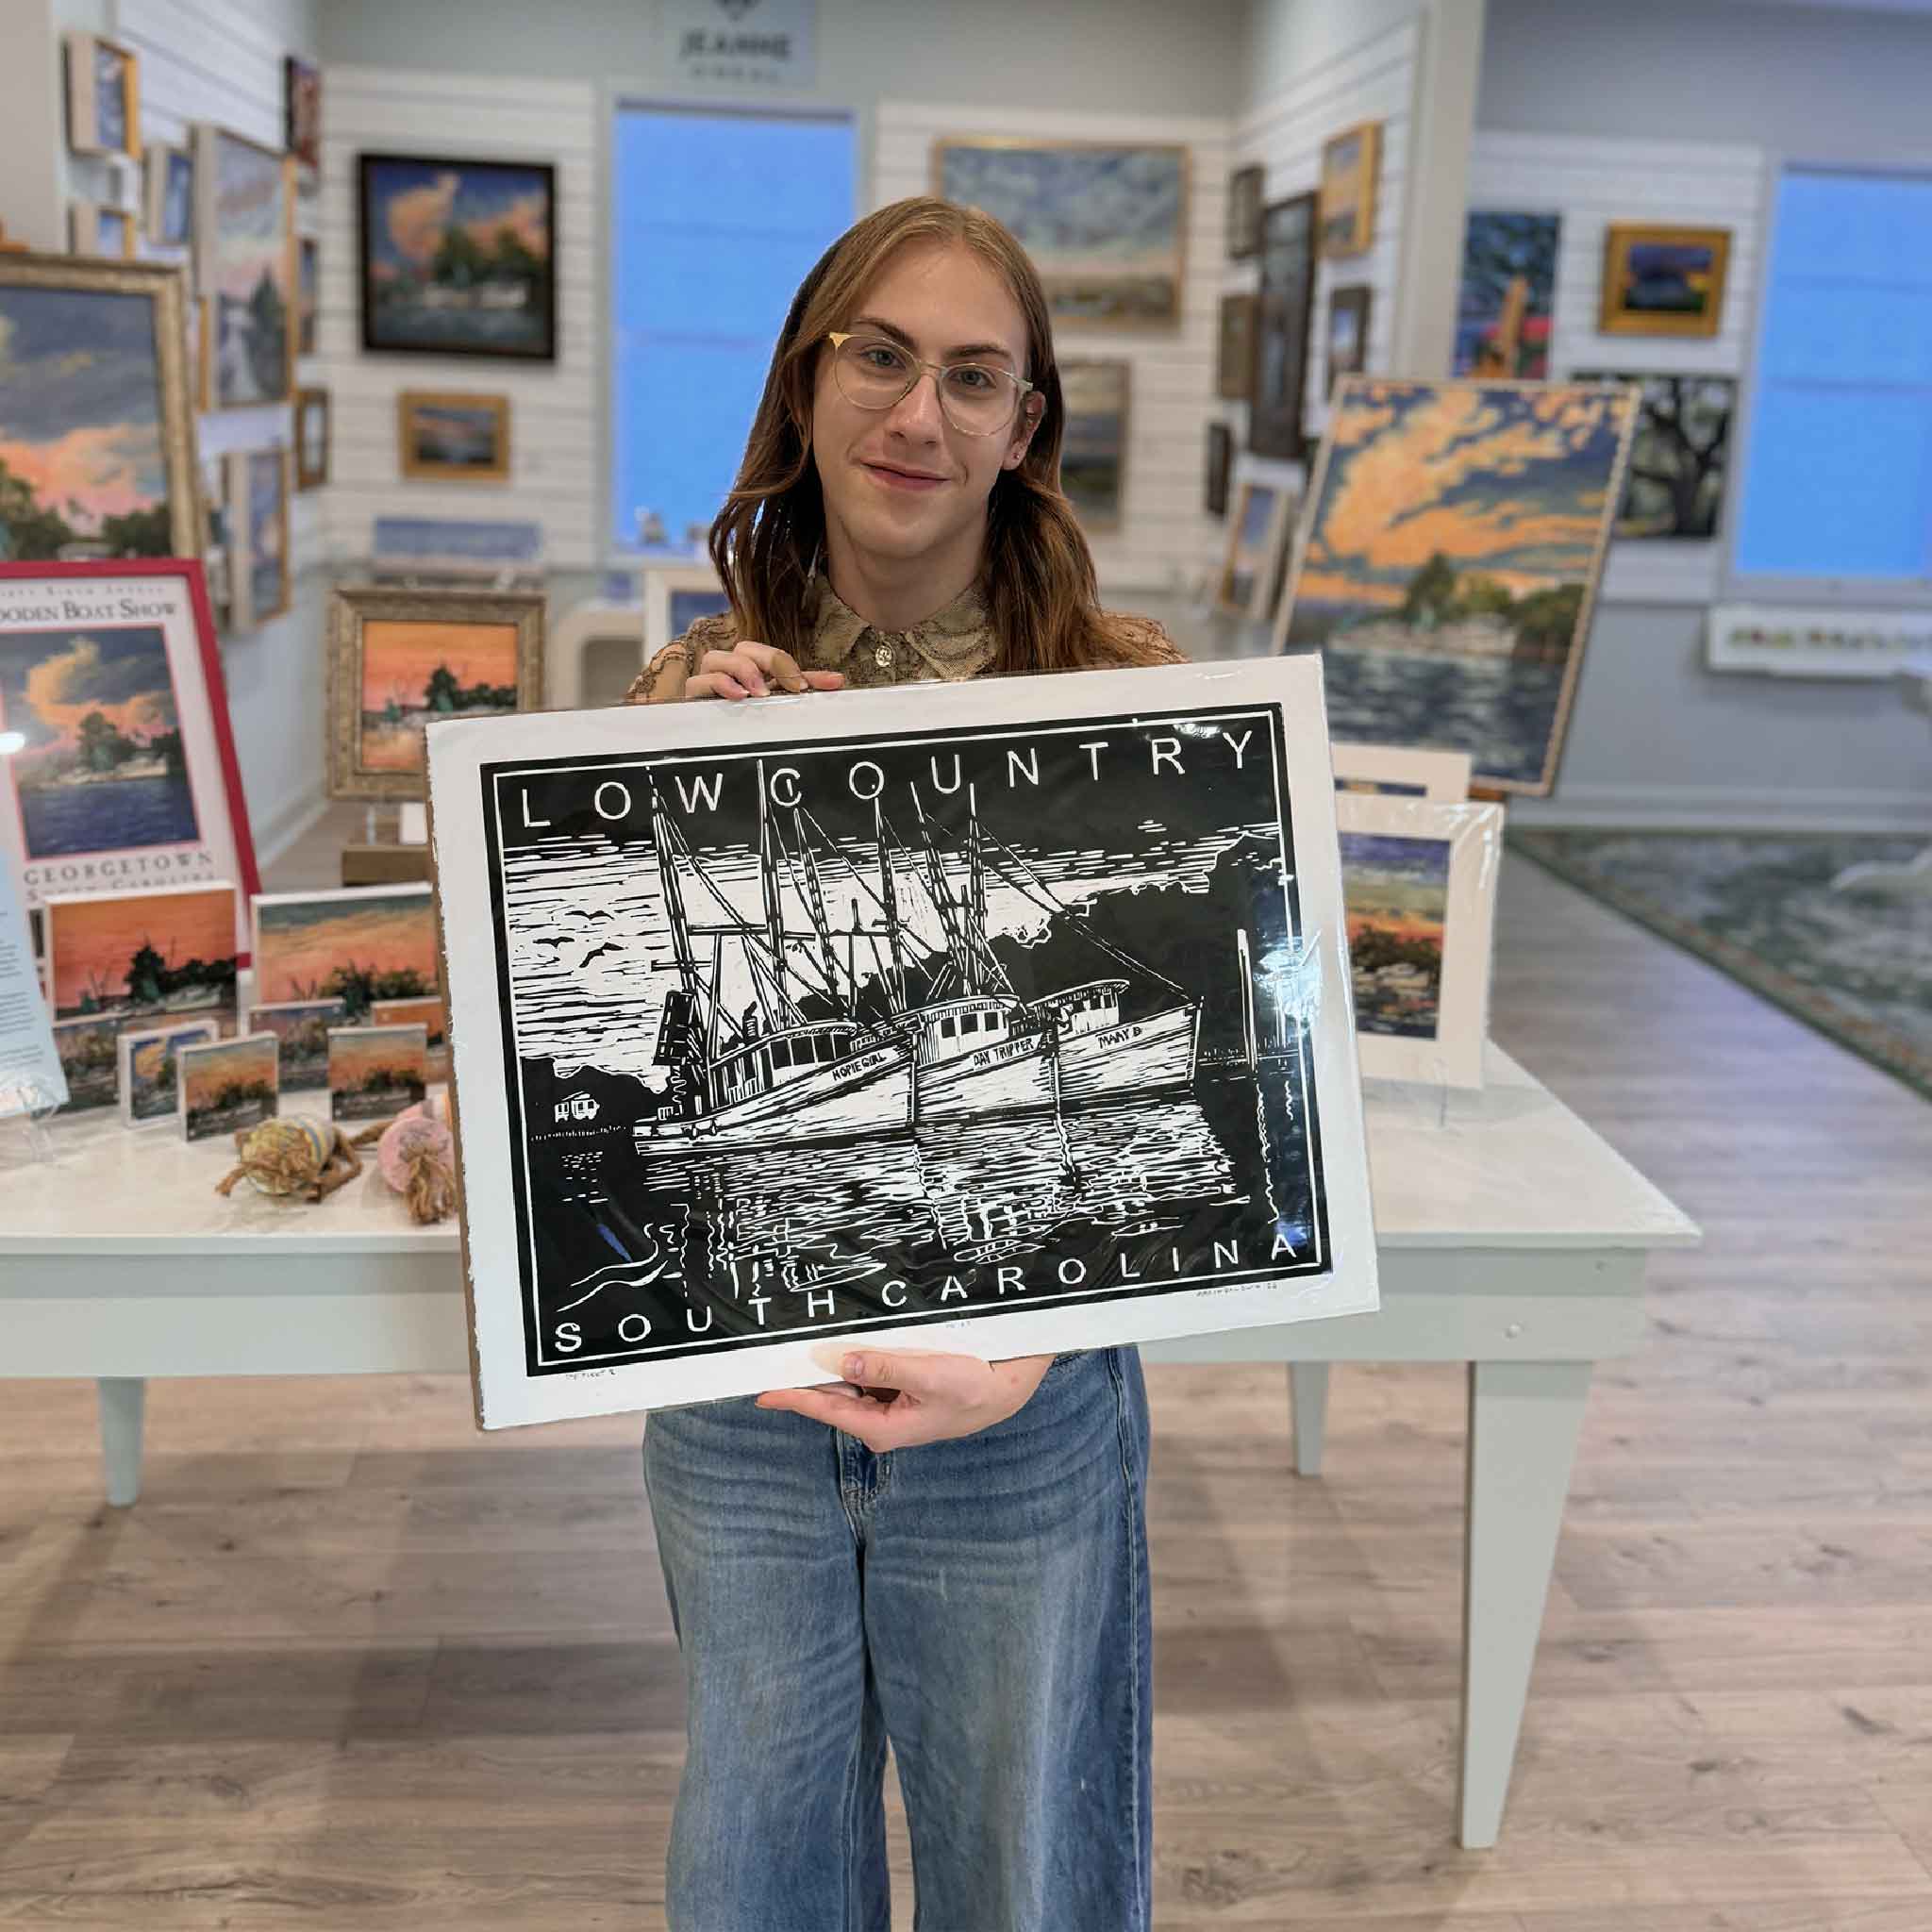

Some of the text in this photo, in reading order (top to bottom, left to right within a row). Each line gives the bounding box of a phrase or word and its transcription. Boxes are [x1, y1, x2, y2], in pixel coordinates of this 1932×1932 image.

[23, 852, 213, 886] GEORGETOWN
[973, 1037, 1035, 1067] DAY TRIPPER
[1097, 1027, 1130, 1049] MARY
[554, 1232, 1298, 1353] SOUTH CAROLINA
